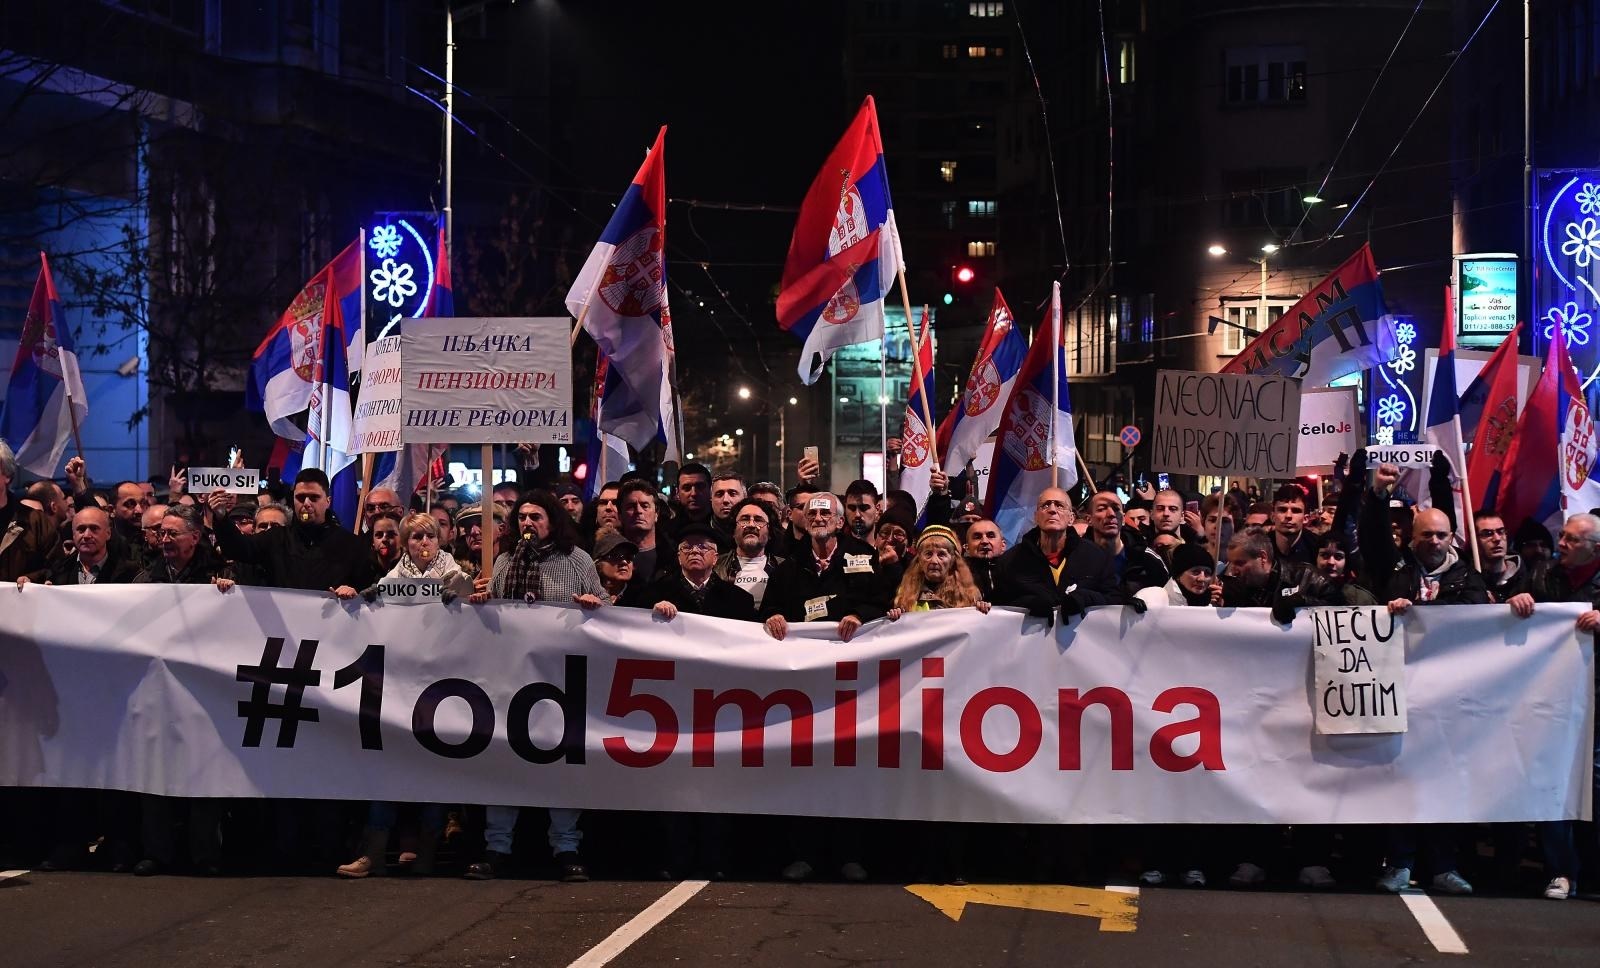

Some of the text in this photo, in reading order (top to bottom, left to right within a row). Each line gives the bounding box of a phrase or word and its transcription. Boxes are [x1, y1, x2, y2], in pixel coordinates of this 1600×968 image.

[442, 335, 531, 352] ПЉАЧКА
[417, 372, 557, 389] ПЕНЗИОНЕРА
[1159, 374, 1286, 423] NEONACI
[405, 409, 568, 427] НИЈЕ РЕФОРМА
[1299, 421, 1352, 435] čeloJe
[1153, 424, 1292, 473] NAPREDNJACI
[1369, 450, 1433, 463] PUKO SI!
[191, 474, 255, 488] PUKO SI!
[377, 583, 440, 597] PUKO SI!
[1337, 646, 1373, 673] DA
[235, 636, 1227, 773] #1od5miliona
